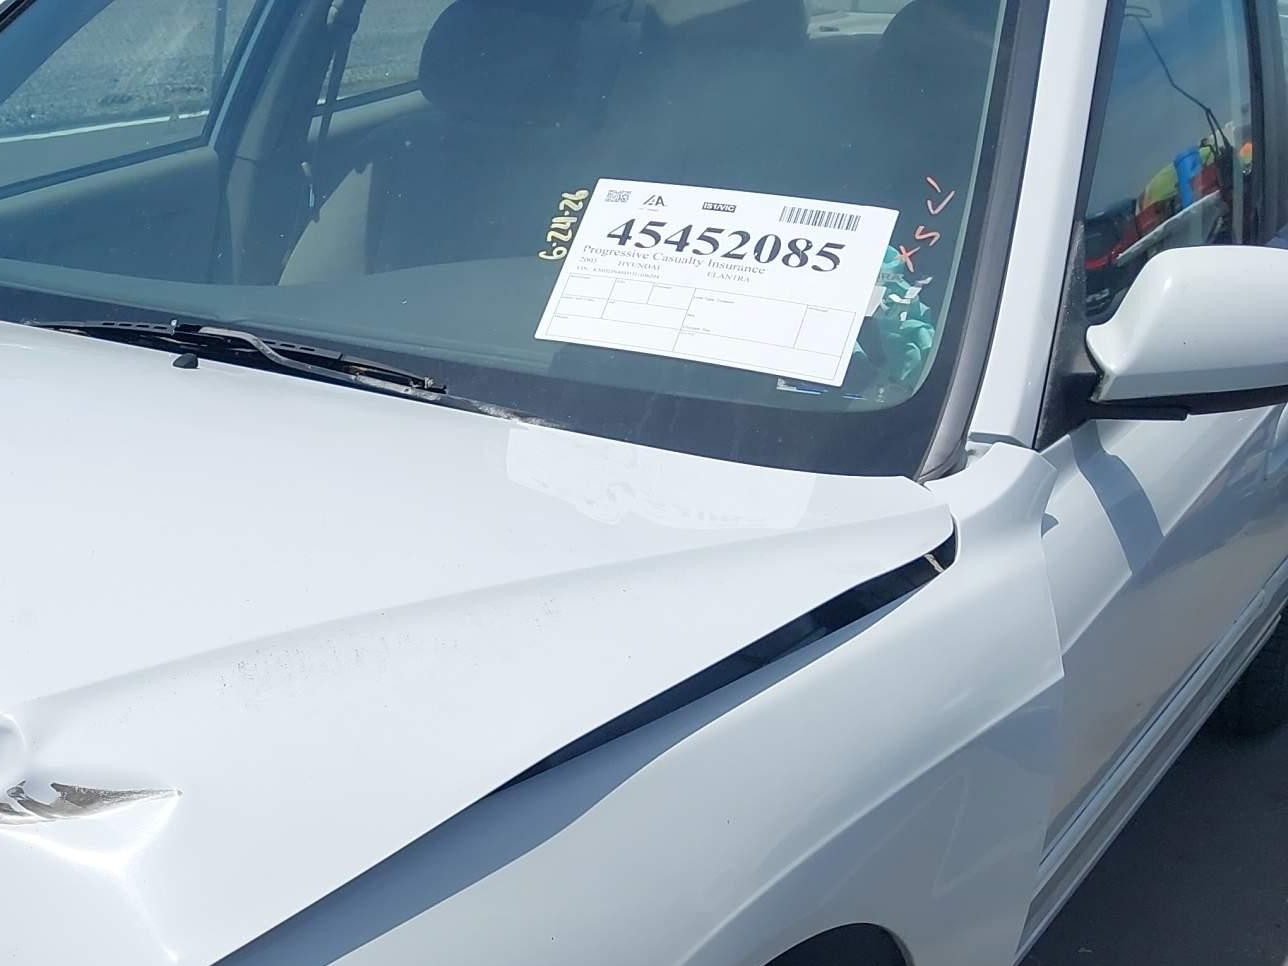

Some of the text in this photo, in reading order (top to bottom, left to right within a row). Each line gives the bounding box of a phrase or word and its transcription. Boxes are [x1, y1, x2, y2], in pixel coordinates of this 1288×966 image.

[583, 244, 766, 275] Progressive Casualty Insurance
[606, 218, 846, 273] 45452085
